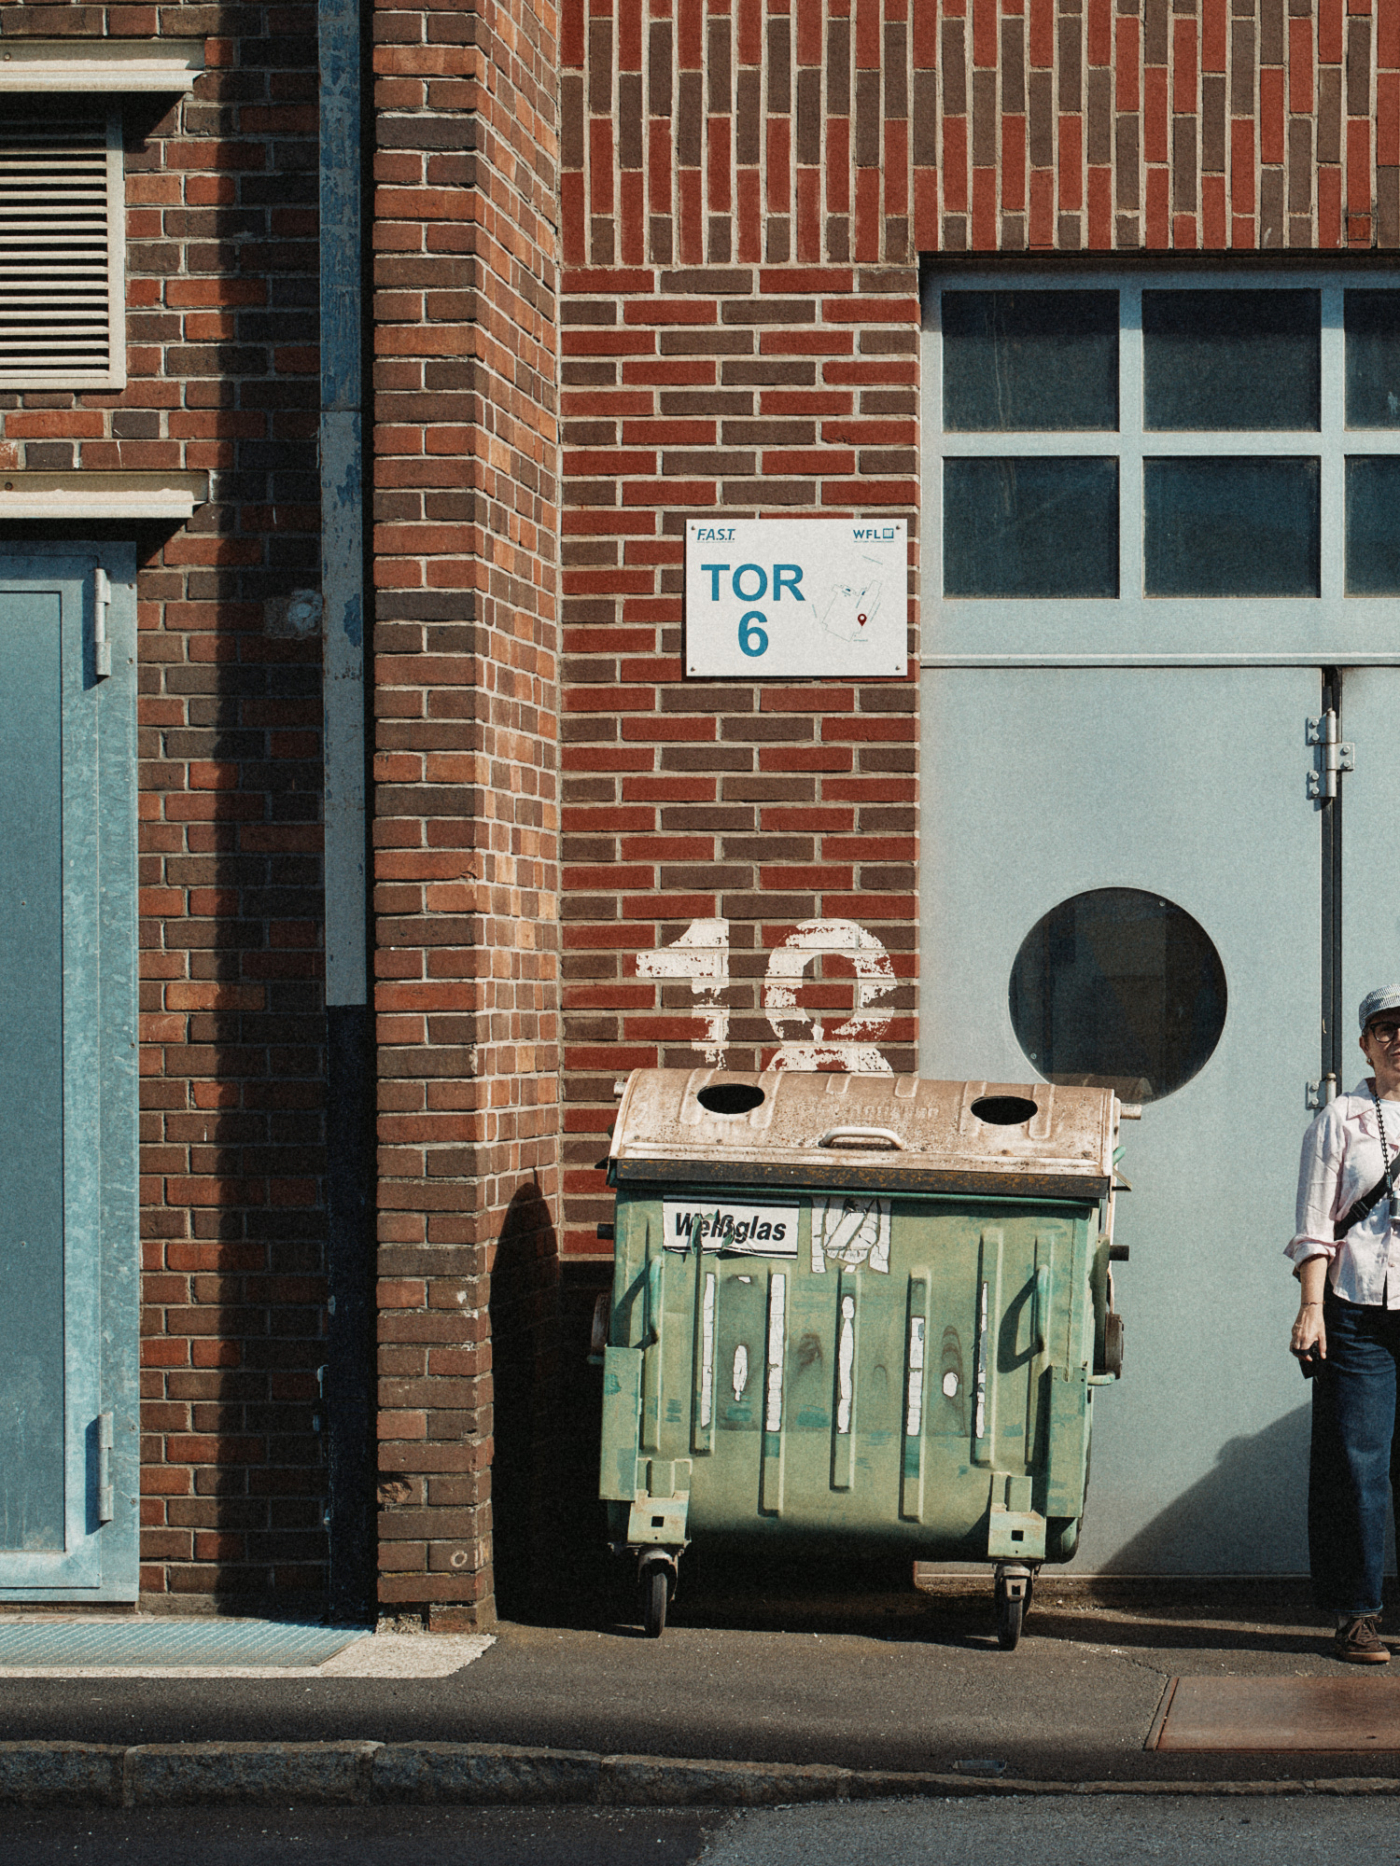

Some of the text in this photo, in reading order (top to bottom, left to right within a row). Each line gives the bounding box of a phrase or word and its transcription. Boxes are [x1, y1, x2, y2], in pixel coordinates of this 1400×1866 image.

[696, 528, 736, 542] F.A.S.T.
[853, 529, 881, 540] WFL
[701, 563, 805, 602] TOR
[738, 611, 769, 657] 6
